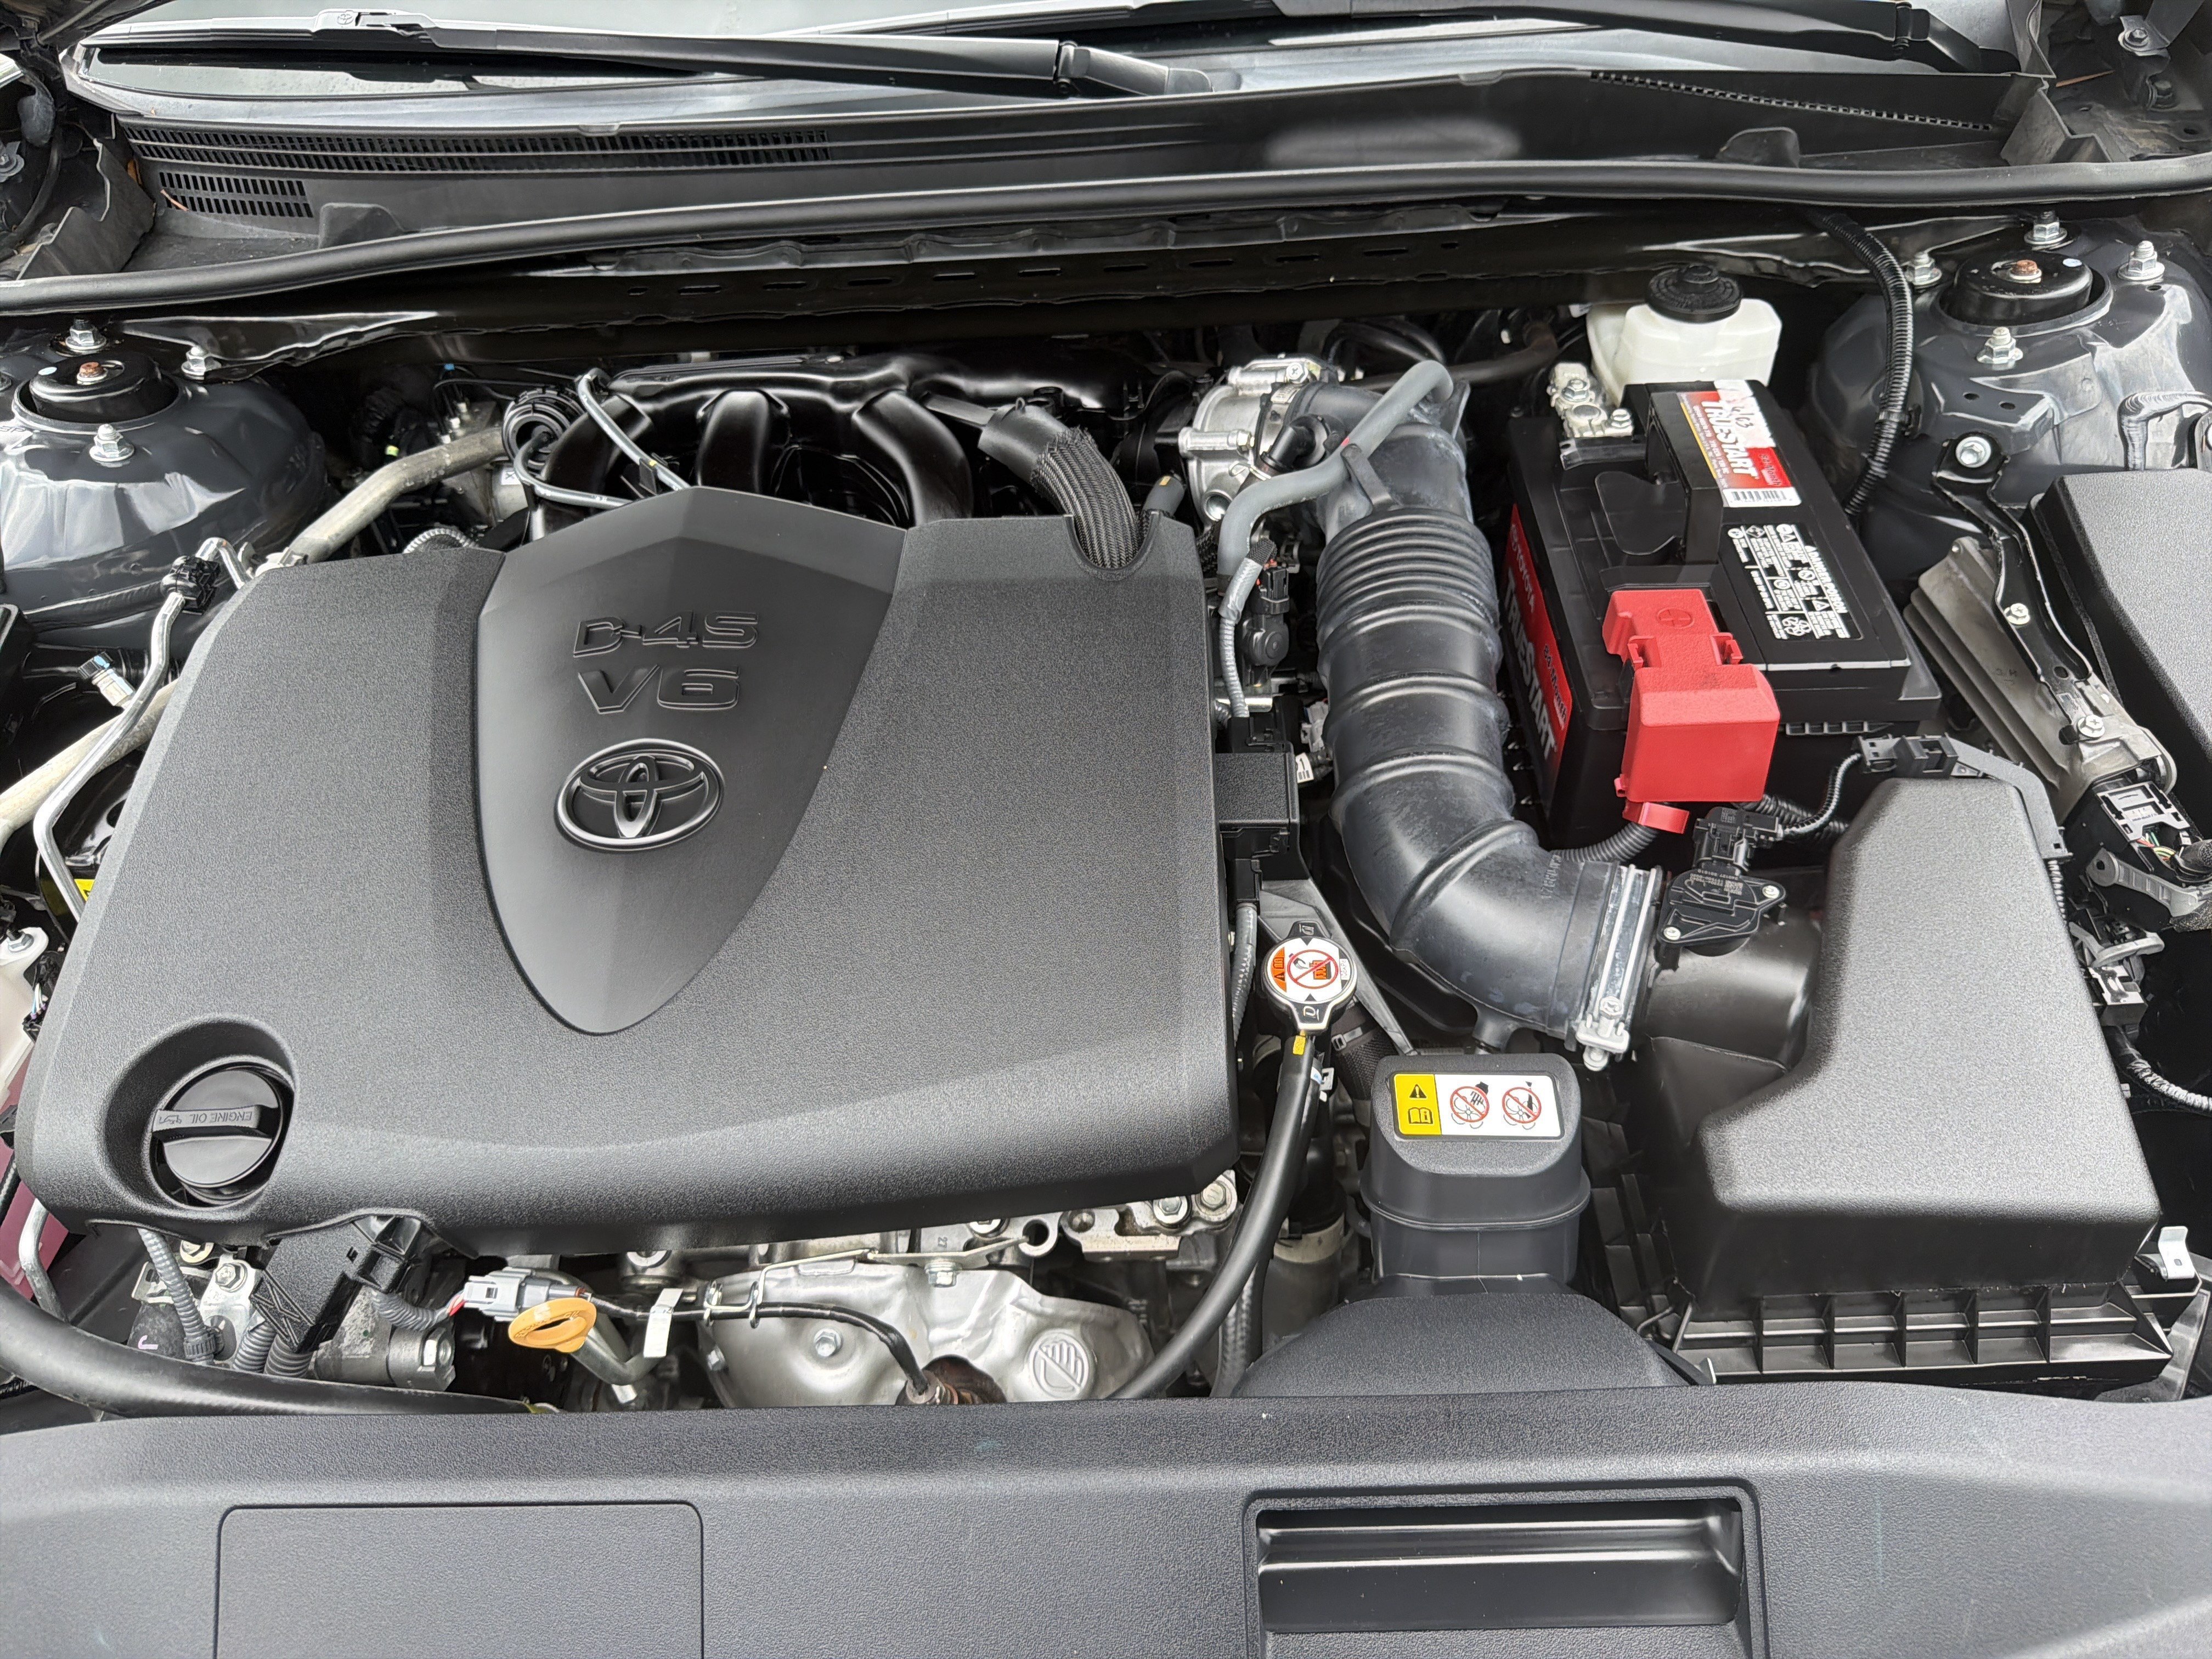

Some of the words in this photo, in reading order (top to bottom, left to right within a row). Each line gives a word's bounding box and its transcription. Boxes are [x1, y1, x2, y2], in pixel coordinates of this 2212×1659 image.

[1701, 401, 1758, 478] TRUESTART
[573, 610, 759, 658] D-4S
[1505, 567, 1557, 760] TRUESTART
[578, 664, 740, 714] V6
[189, 1113, 207, 1124] OIL
[211, 1111, 253, 1123] ENGINE
